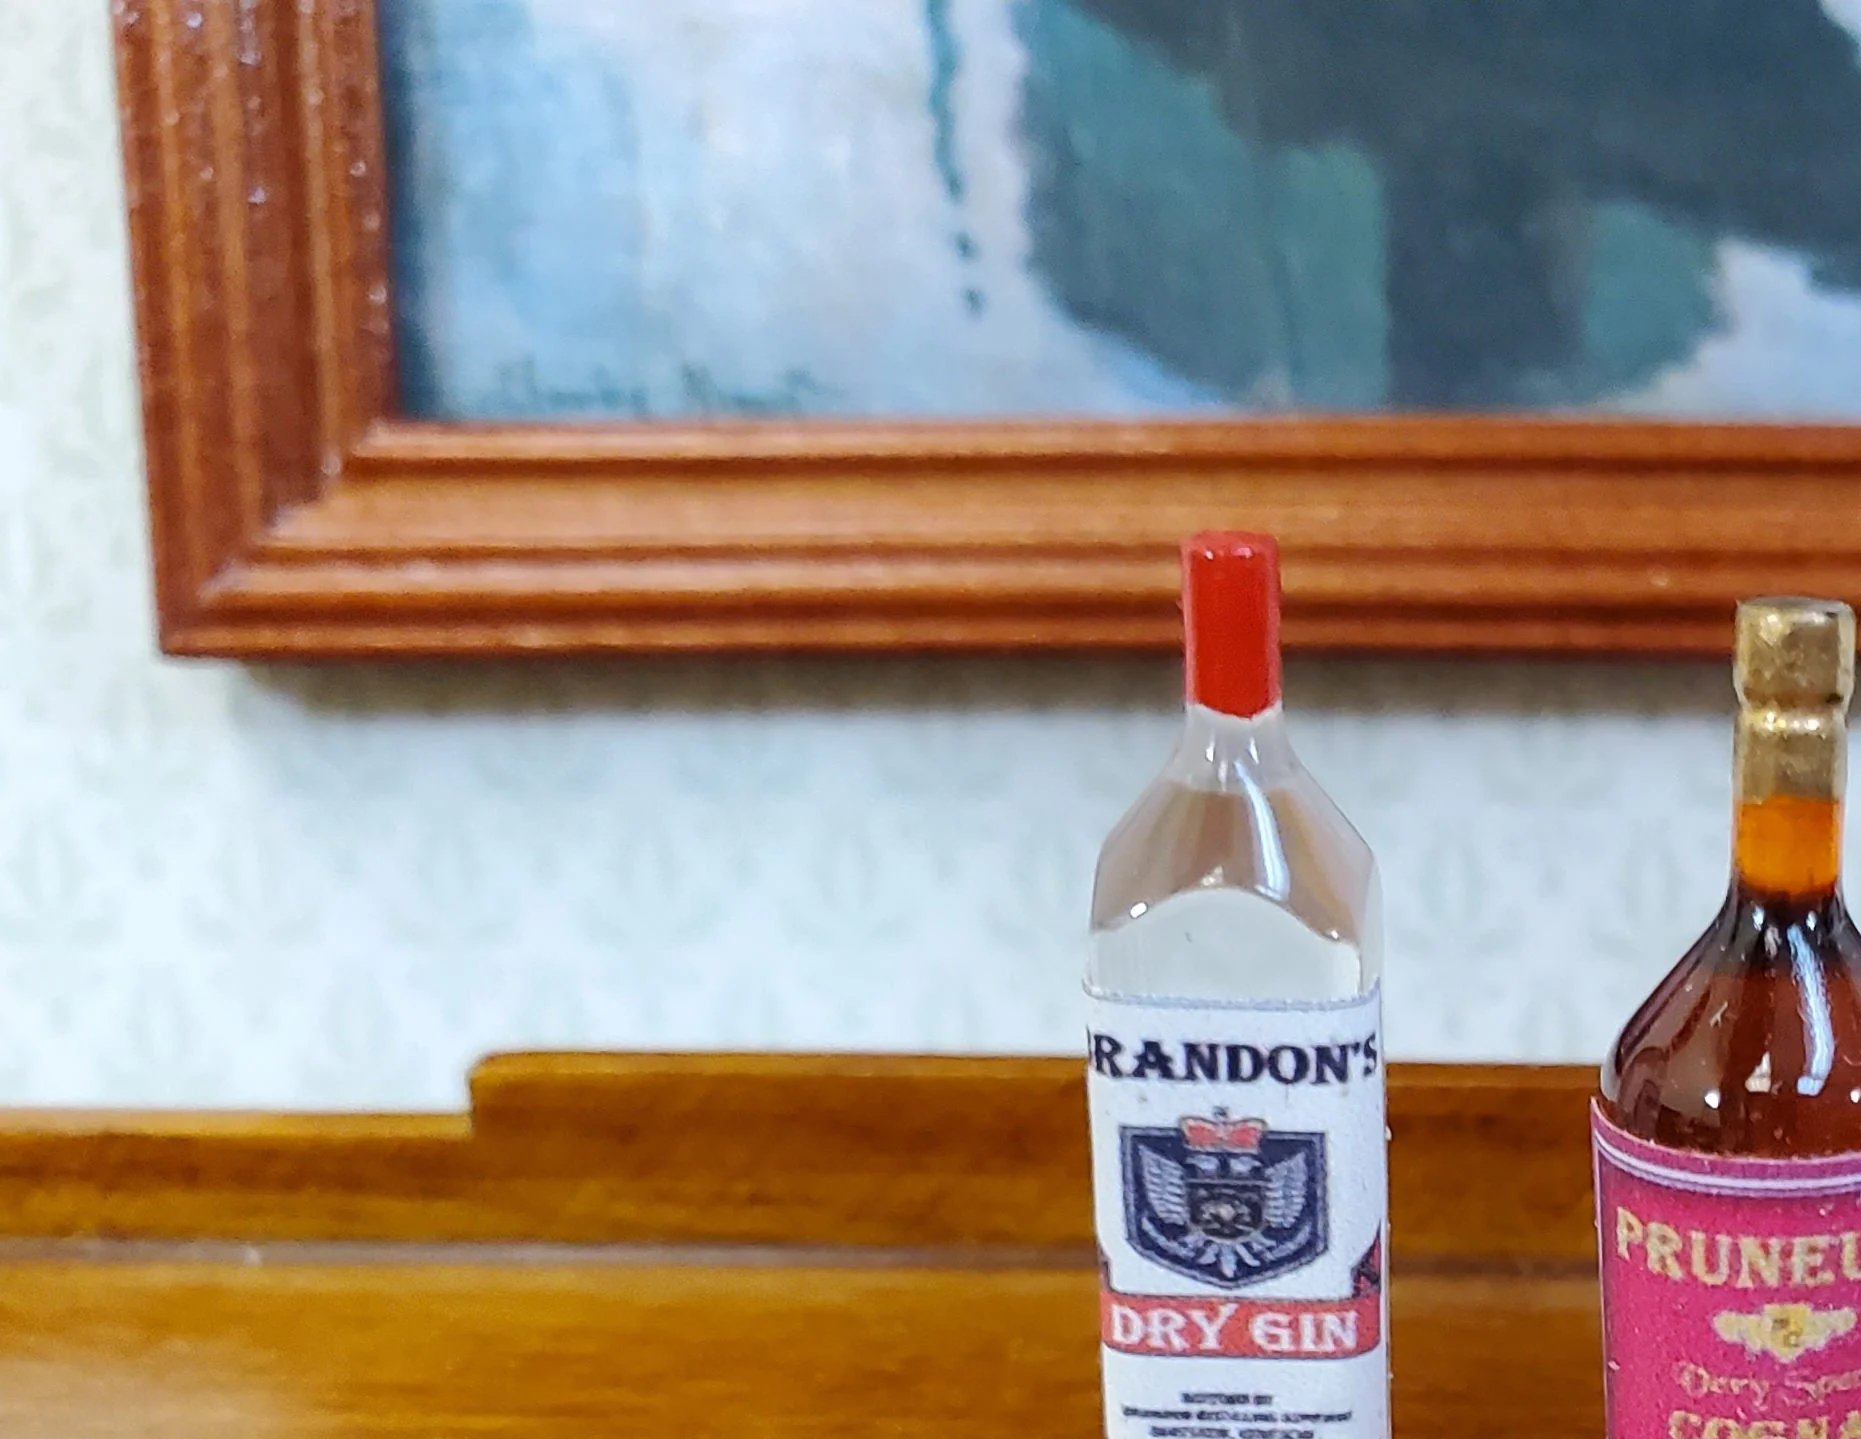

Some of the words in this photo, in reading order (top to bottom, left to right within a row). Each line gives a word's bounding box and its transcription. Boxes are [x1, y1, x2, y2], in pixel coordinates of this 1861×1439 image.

[1086, 1028, 1377, 1085] RANDON'S
[1111, 1303, 1239, 1350] DRY
[1249, 1311, 1358, 1353] GIN
